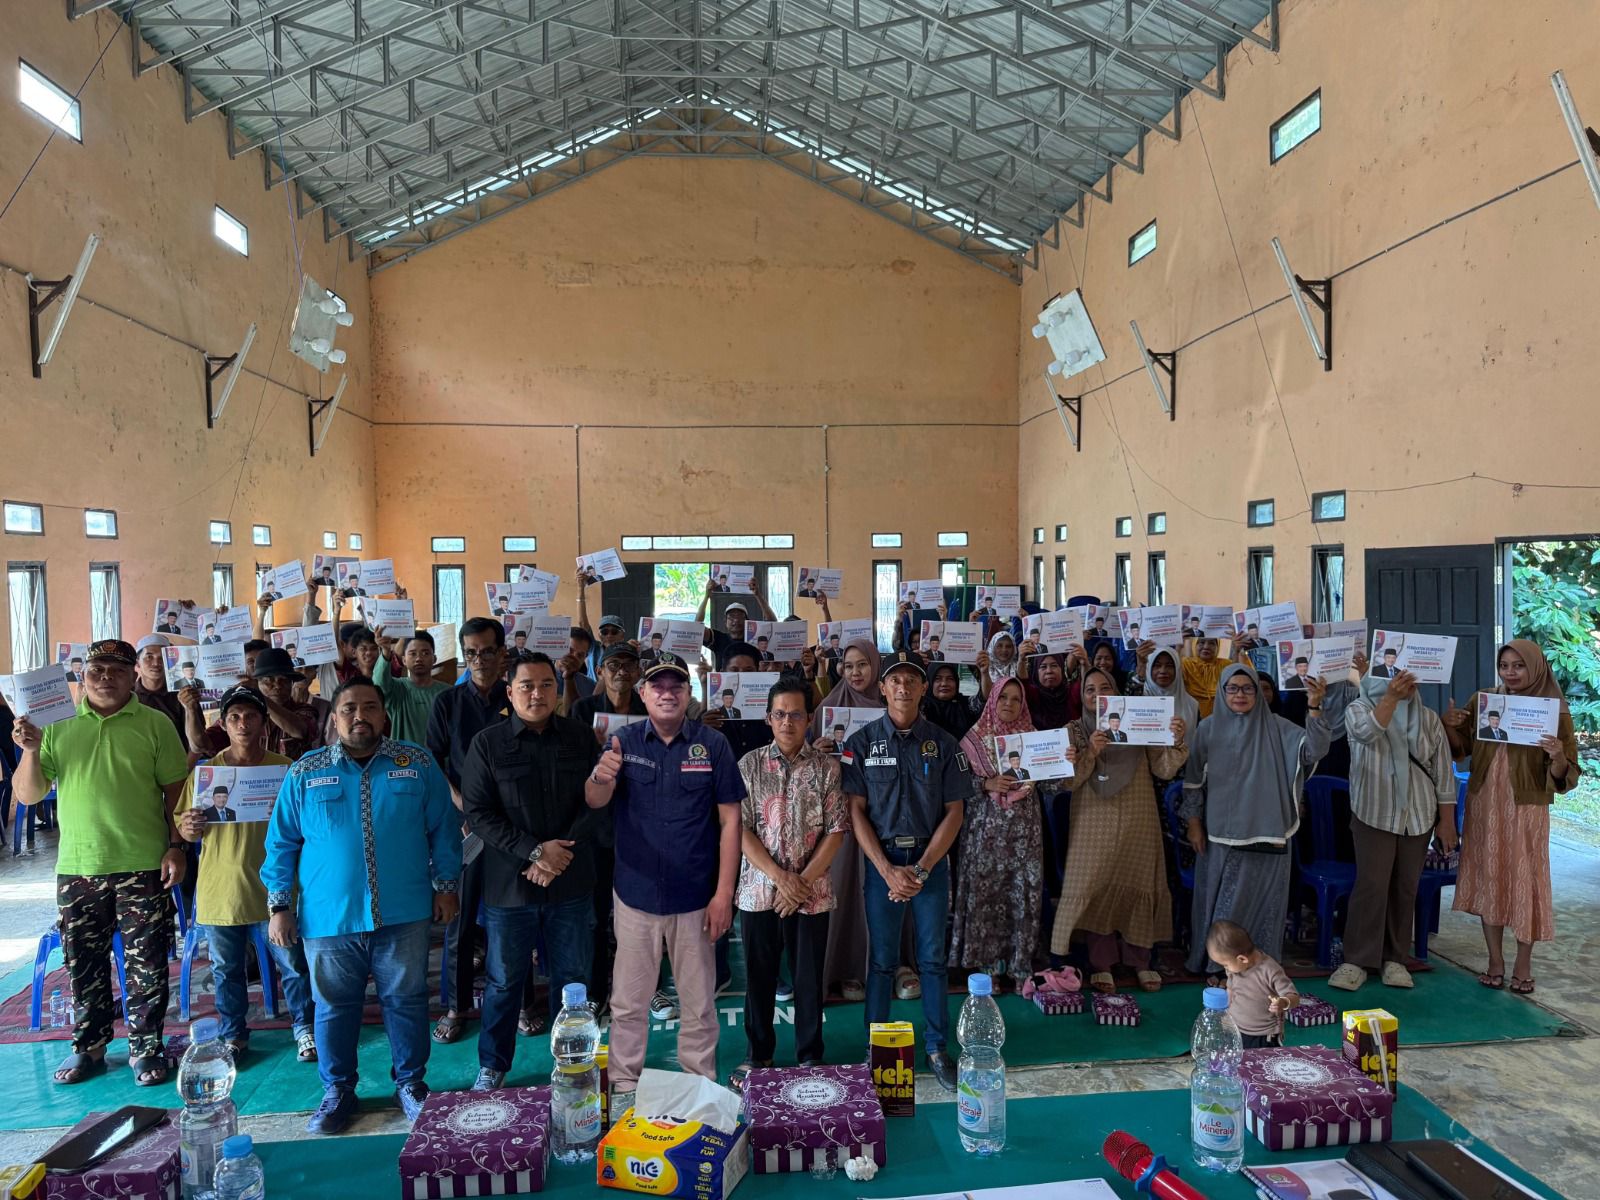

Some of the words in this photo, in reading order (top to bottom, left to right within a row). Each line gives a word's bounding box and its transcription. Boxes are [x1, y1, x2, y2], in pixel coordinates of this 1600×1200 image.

[871, 744, 886, 755] AF
[873, 1060, 913, 1085] teh
[1199, 1121, 1234, 1135] Minerale
[1210, 1118, 1222, 1127] Le
[641, 1132, 657, 1141] Food
